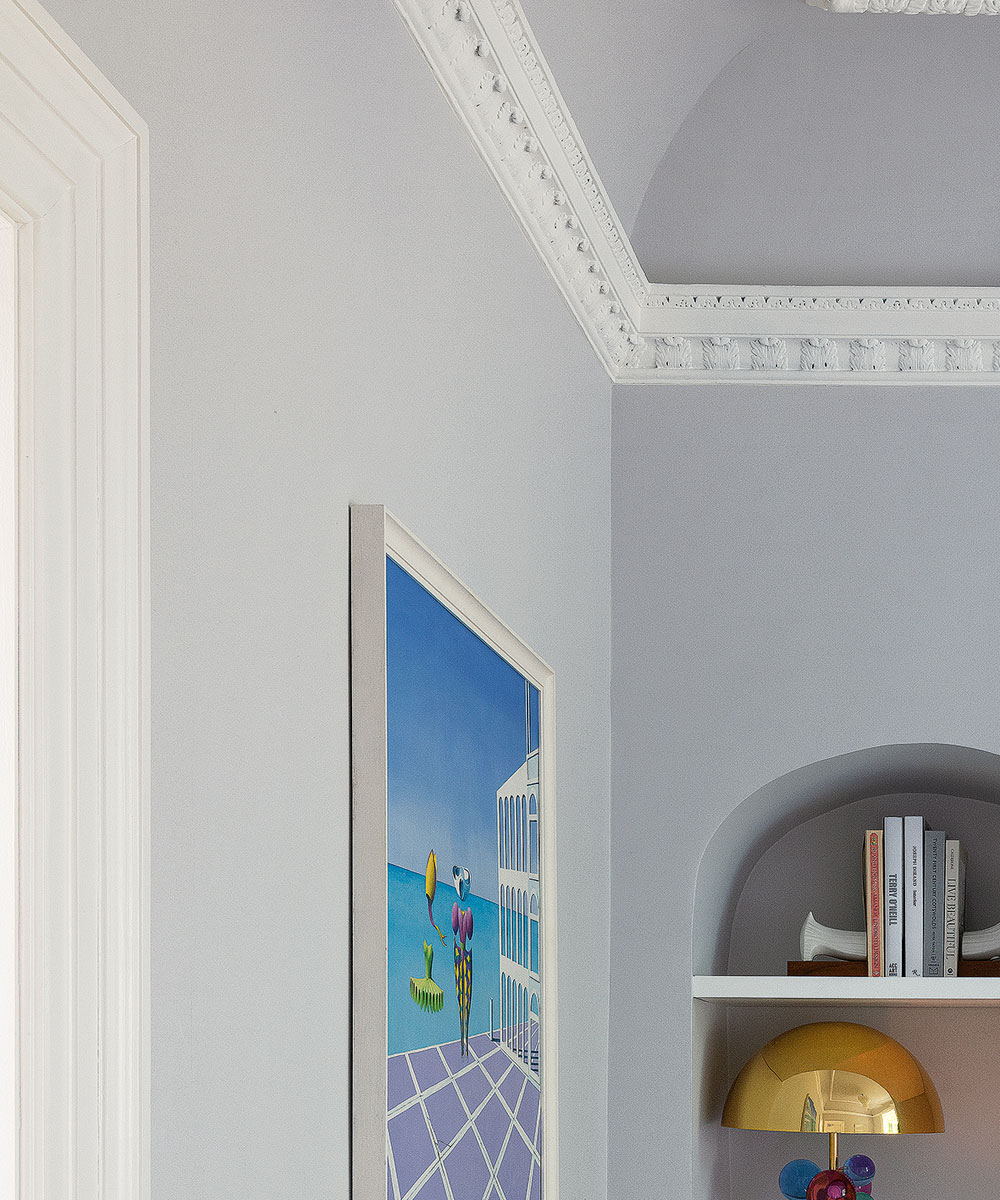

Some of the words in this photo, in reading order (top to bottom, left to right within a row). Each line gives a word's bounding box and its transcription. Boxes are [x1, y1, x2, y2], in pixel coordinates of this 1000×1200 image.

[889, 874, 897, 898] TERRY
[947, 878, 956, 901] LIVE
[889, 898, 897, 926] O'NEILL
[946, 903, 956, 960] BEAUTIFUL
